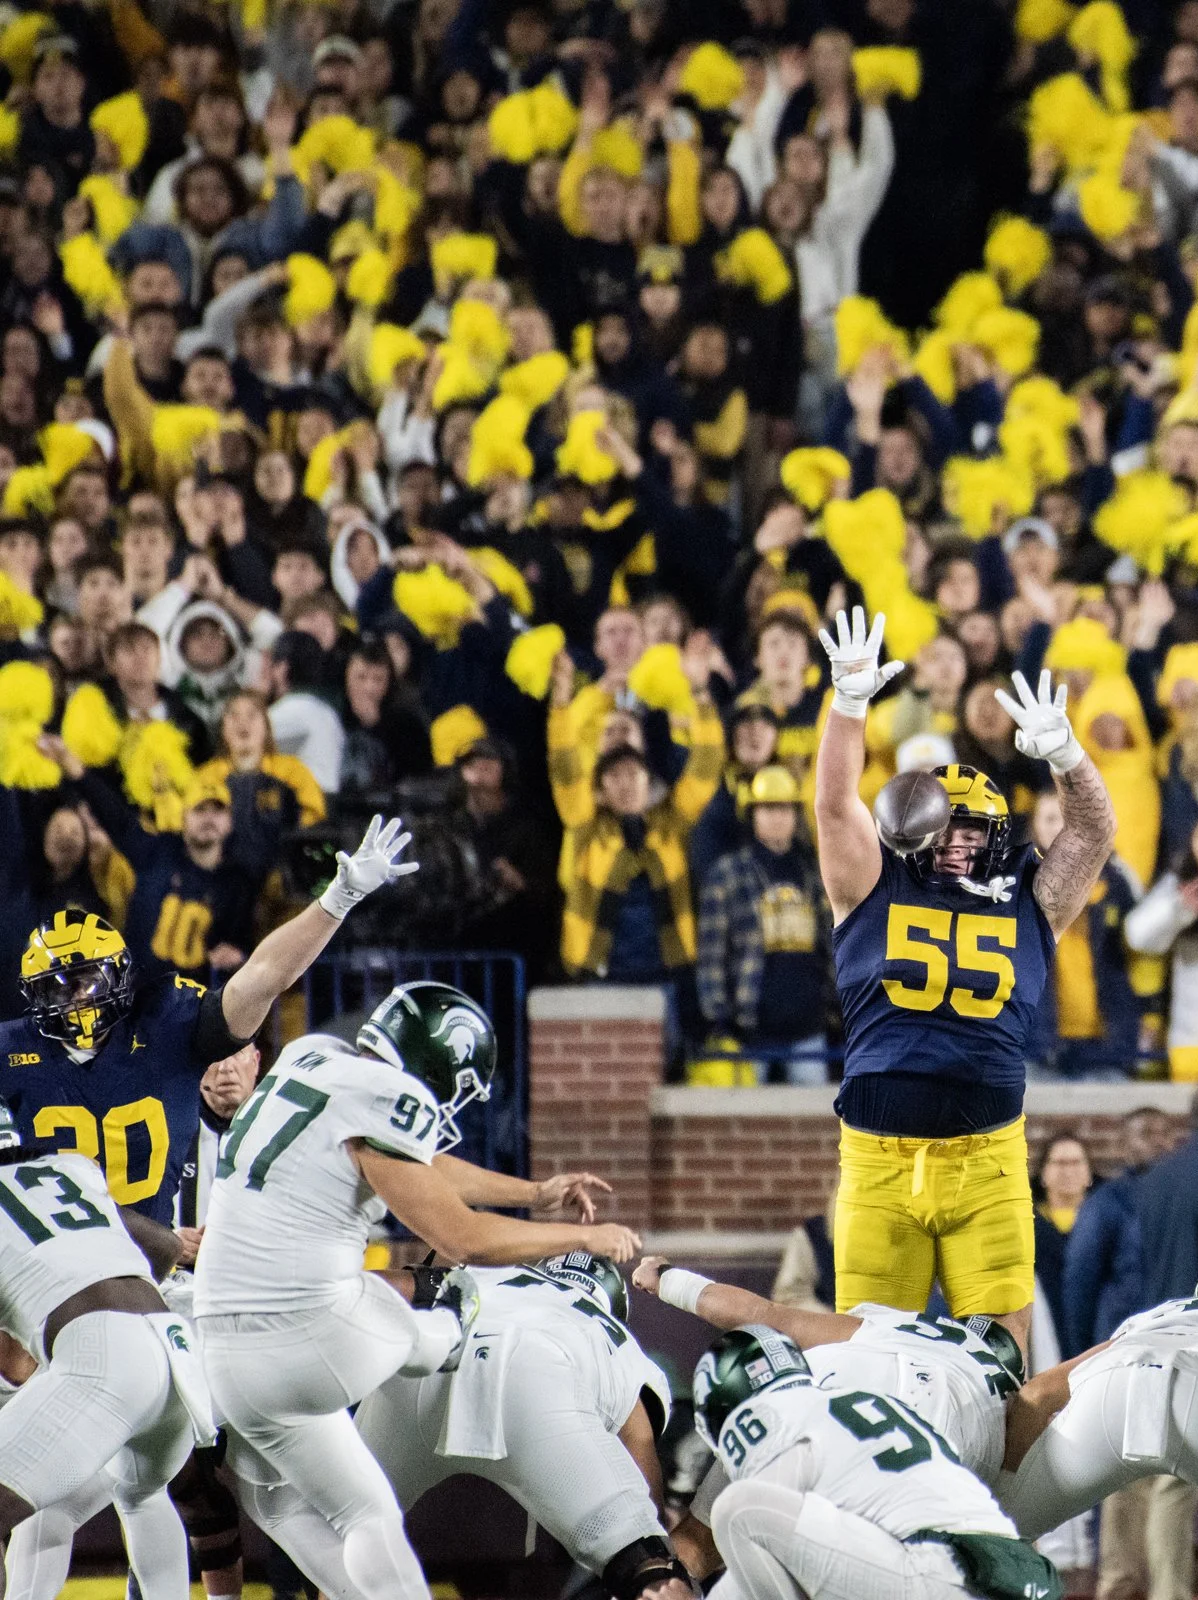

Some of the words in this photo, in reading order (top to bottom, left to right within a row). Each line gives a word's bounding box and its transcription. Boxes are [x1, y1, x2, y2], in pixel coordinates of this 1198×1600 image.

[881, 903, 1017, 1019] 55
[291, 1051, 330, 1071] KIM
[215, 1075, 331, 1191] 97
[390, 1093, 437, 1141] 97
[0, 1166, 111, 1247] 13
[722, 1408, 768, 1467] 96
